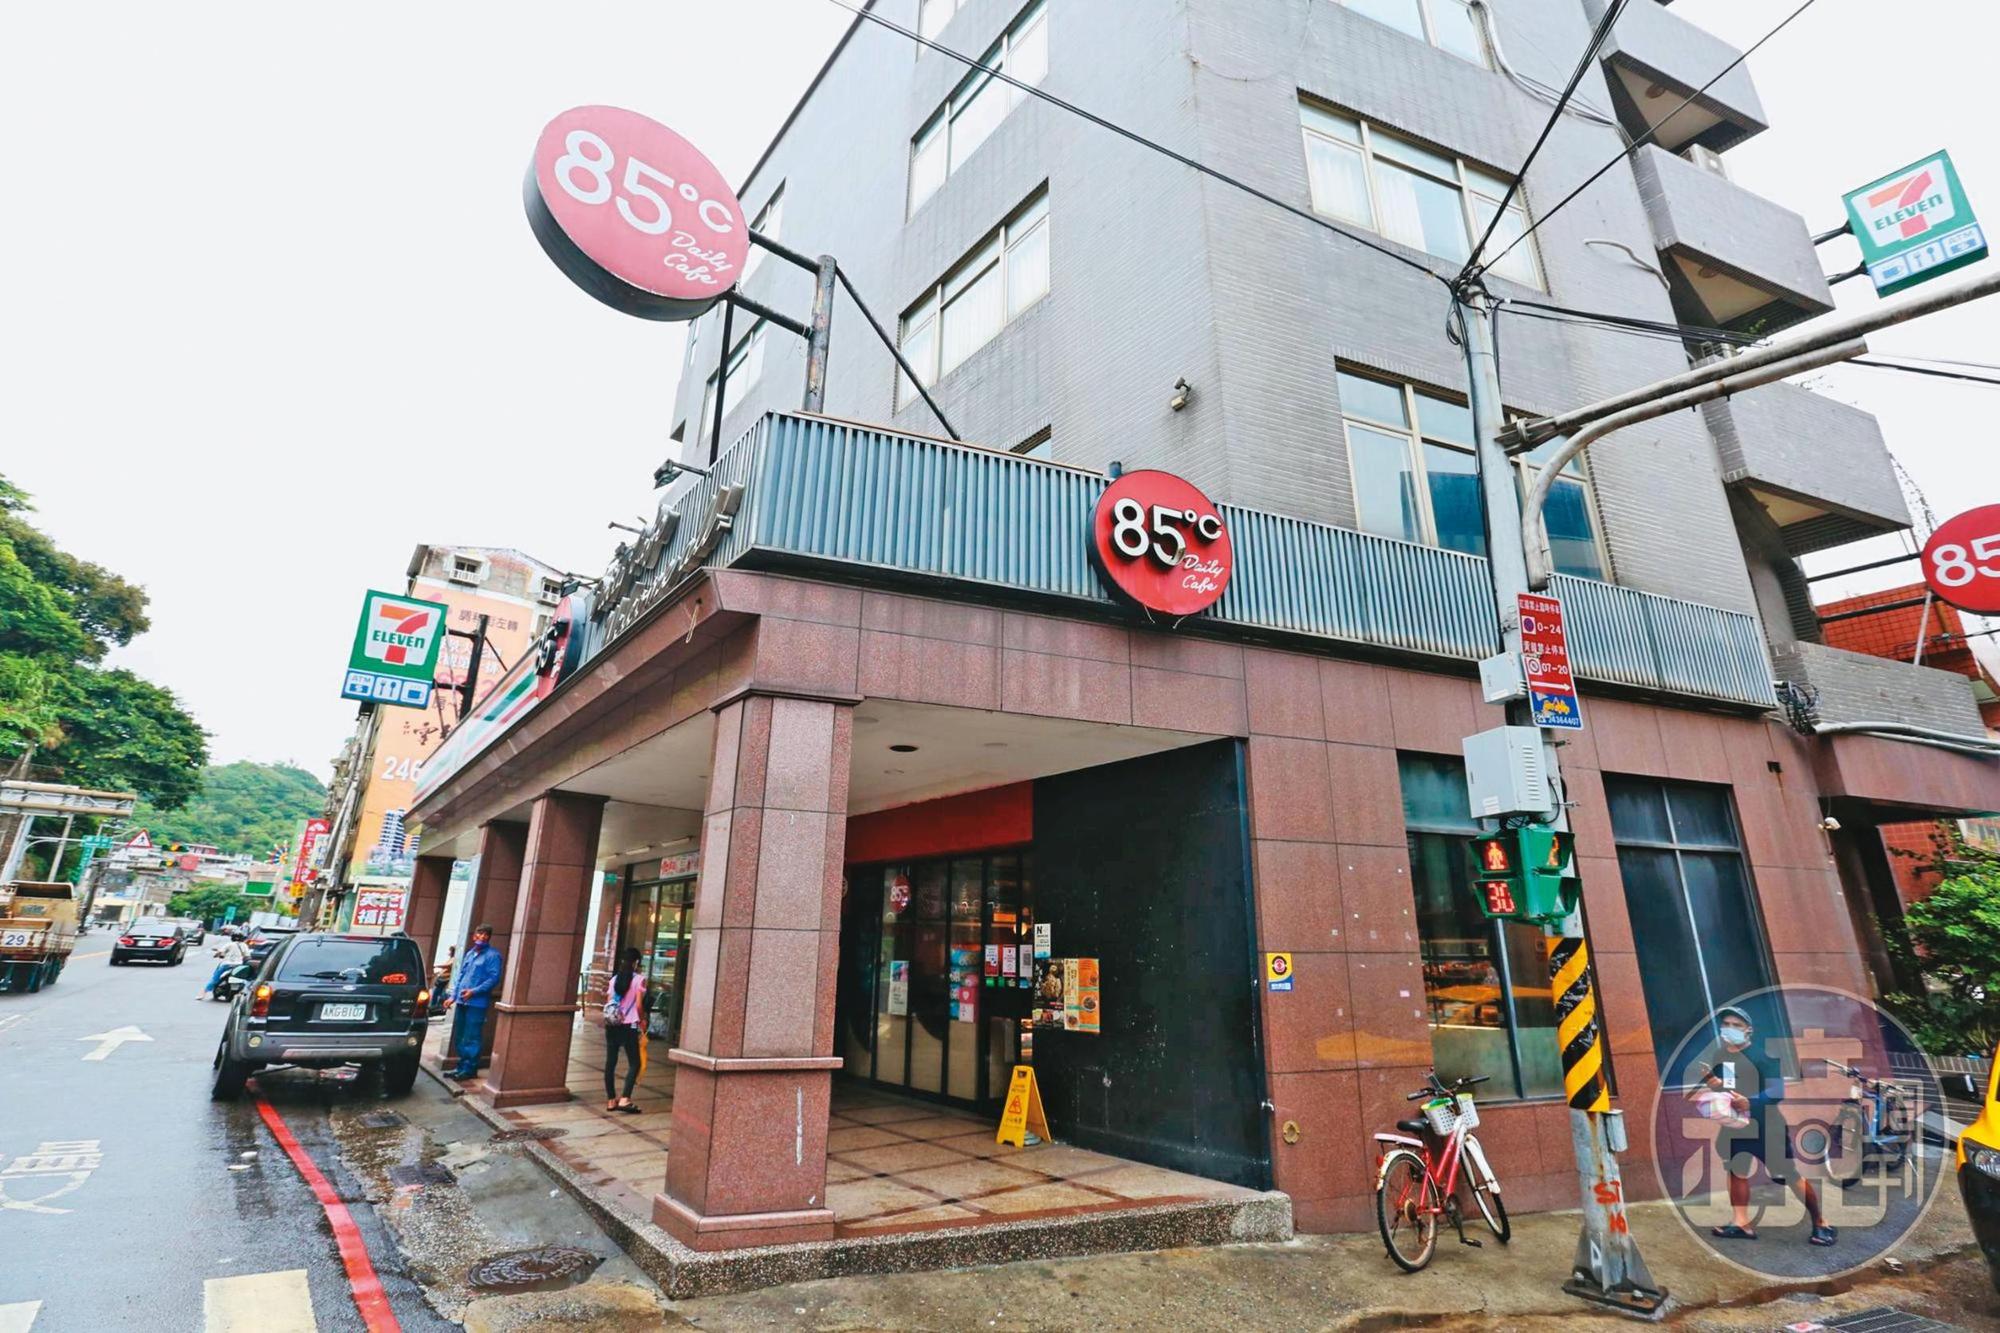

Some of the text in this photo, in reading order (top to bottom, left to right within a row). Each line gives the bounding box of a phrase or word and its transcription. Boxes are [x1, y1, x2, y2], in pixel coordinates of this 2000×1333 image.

[554, 129, 734, 235] 85°C
[1866, 170, 1933, 239] 7
[671, 229, 733, 273] Daily
[663, 253, 718, 285] Cafe
[1112, 498, 1223, 567] 85°C
[1183, 554, 1225, 578] Daily
[1182, 575, 1218, 594] Cafe
[379, 603, 430, 665] 7
[1541, 663, 1568, 675] 07-20
[1488, 882, 1515, 913] 30
[5, 934, 25, 946] 29
